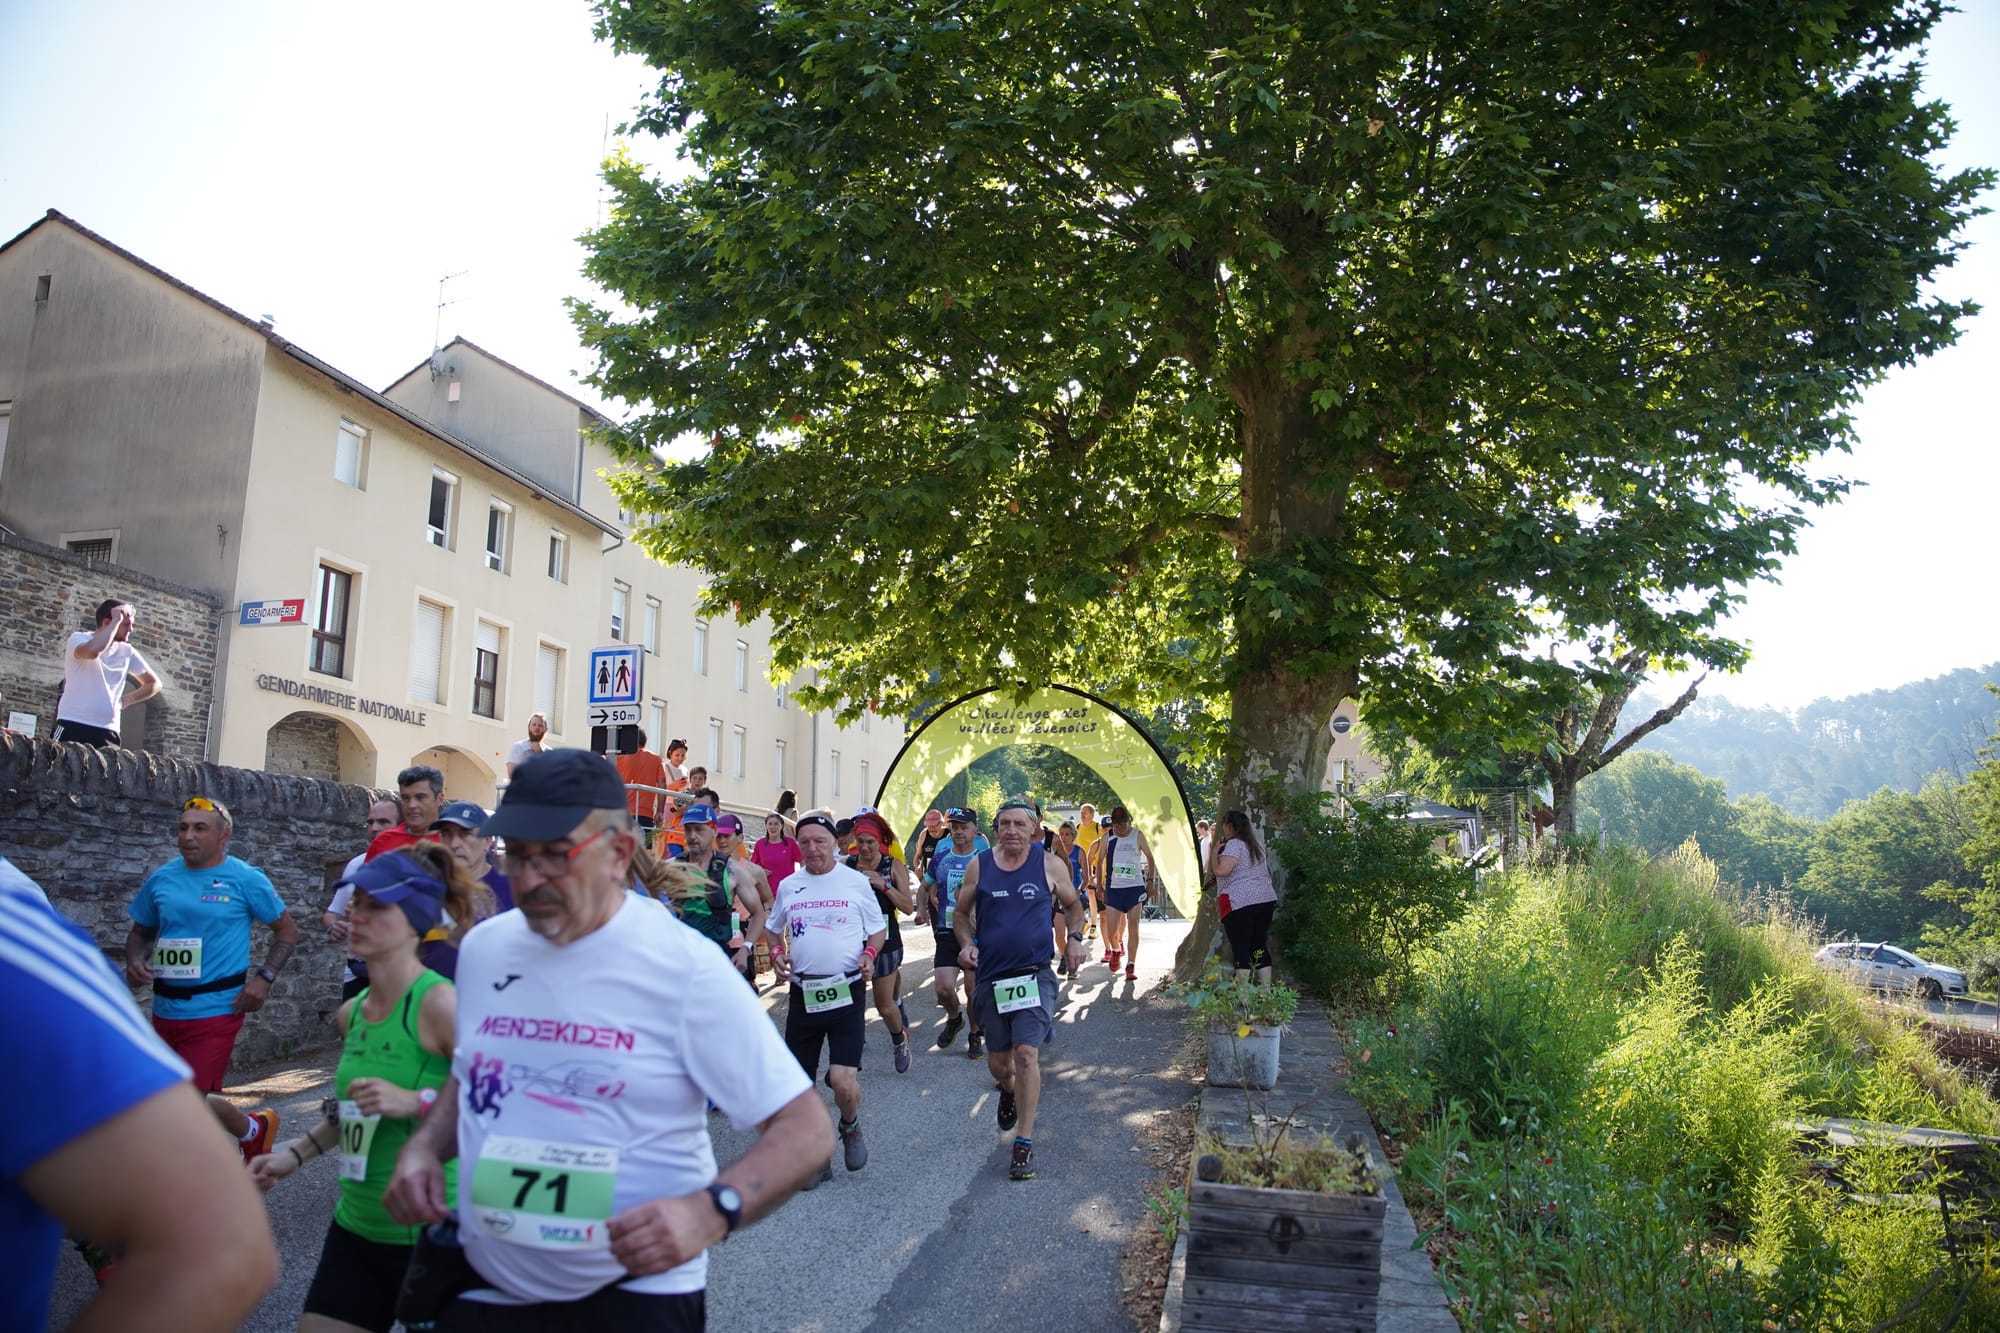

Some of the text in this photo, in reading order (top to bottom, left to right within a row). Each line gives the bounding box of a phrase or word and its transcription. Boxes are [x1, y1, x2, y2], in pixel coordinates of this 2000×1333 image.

[249, 606, 296, 617] GENDARMERIE
[256, 673, 426, 726] GENDARMERIE NATIONALE
[968, 707, 1050, 723] Challenge
[959, 722, 1016, 734] vallées
[1119, 866, 1131, 875] 72
[157, 949, 193, 966] 100
[815, 987, 838, 1003] 69
[1004, 985, 1027, 1001] 70
[475, 1014, 635, 1052] MENDEKIDEN
[511, 1167, 570, 1214] 71
